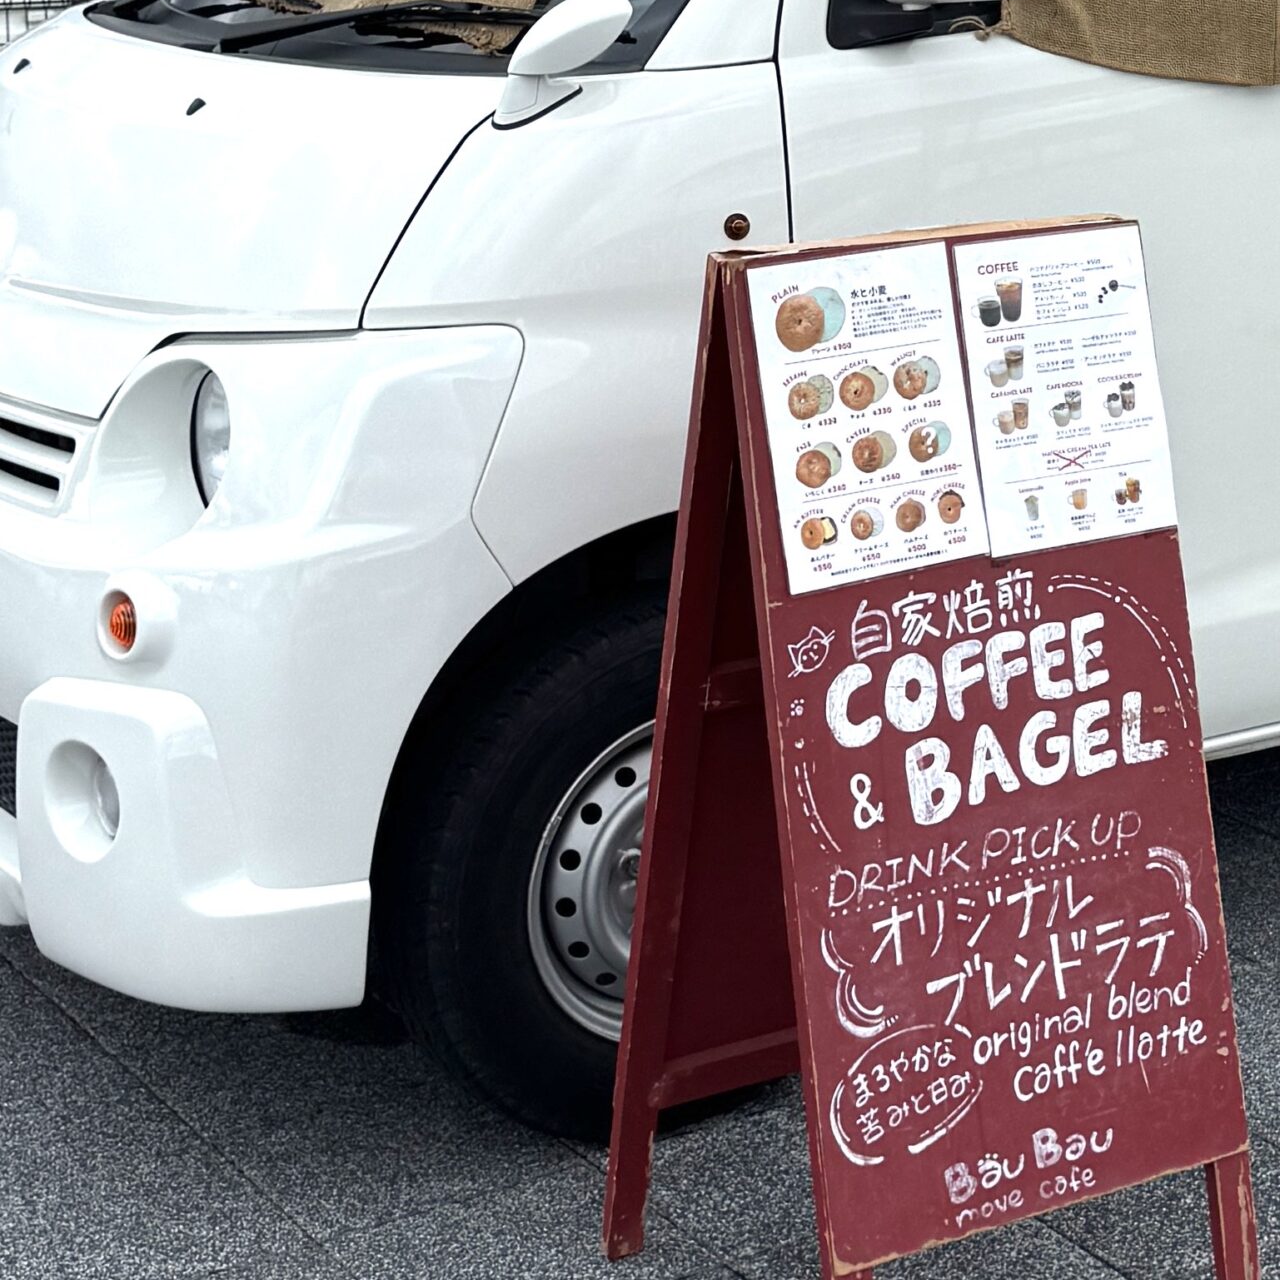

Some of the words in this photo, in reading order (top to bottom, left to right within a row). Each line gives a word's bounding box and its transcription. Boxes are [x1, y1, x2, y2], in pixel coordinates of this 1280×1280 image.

[771, 284, 799, 304] PLAIN
[850, 285, 887, 300] 水と小麦
[977, 261, 1019, 276] COFFEE
[832, 358, 869, 382] CHOCOLATE
[986, 334, 1004, 345] CAFE
[851, 568, 1041, 661] 自家焙煎
[825, 612, 1110, 748] COFFEE
[849, 773, 885, 830] &
[904, 691, 1169, 826] BAGEL
[828, 840, 969, 909] DRINK
[981, 818, 1080, 872] PICK
[1092, 811, 1141, 851] UP
[870, 875, 1094, 966] オリジナル
[926, 912, 1175, 1027] ブレンドラテ
[973, 992, 1092, 1066] original
[1108, 966, 1192, 1020] blend
[852, 1038, 957, 1108] まろやかな
[1032, 1127, 1114, 1169] Bau
[954, 1188, 1025, 1229] move
[1039, 1165, 1096, 1199] cafe
